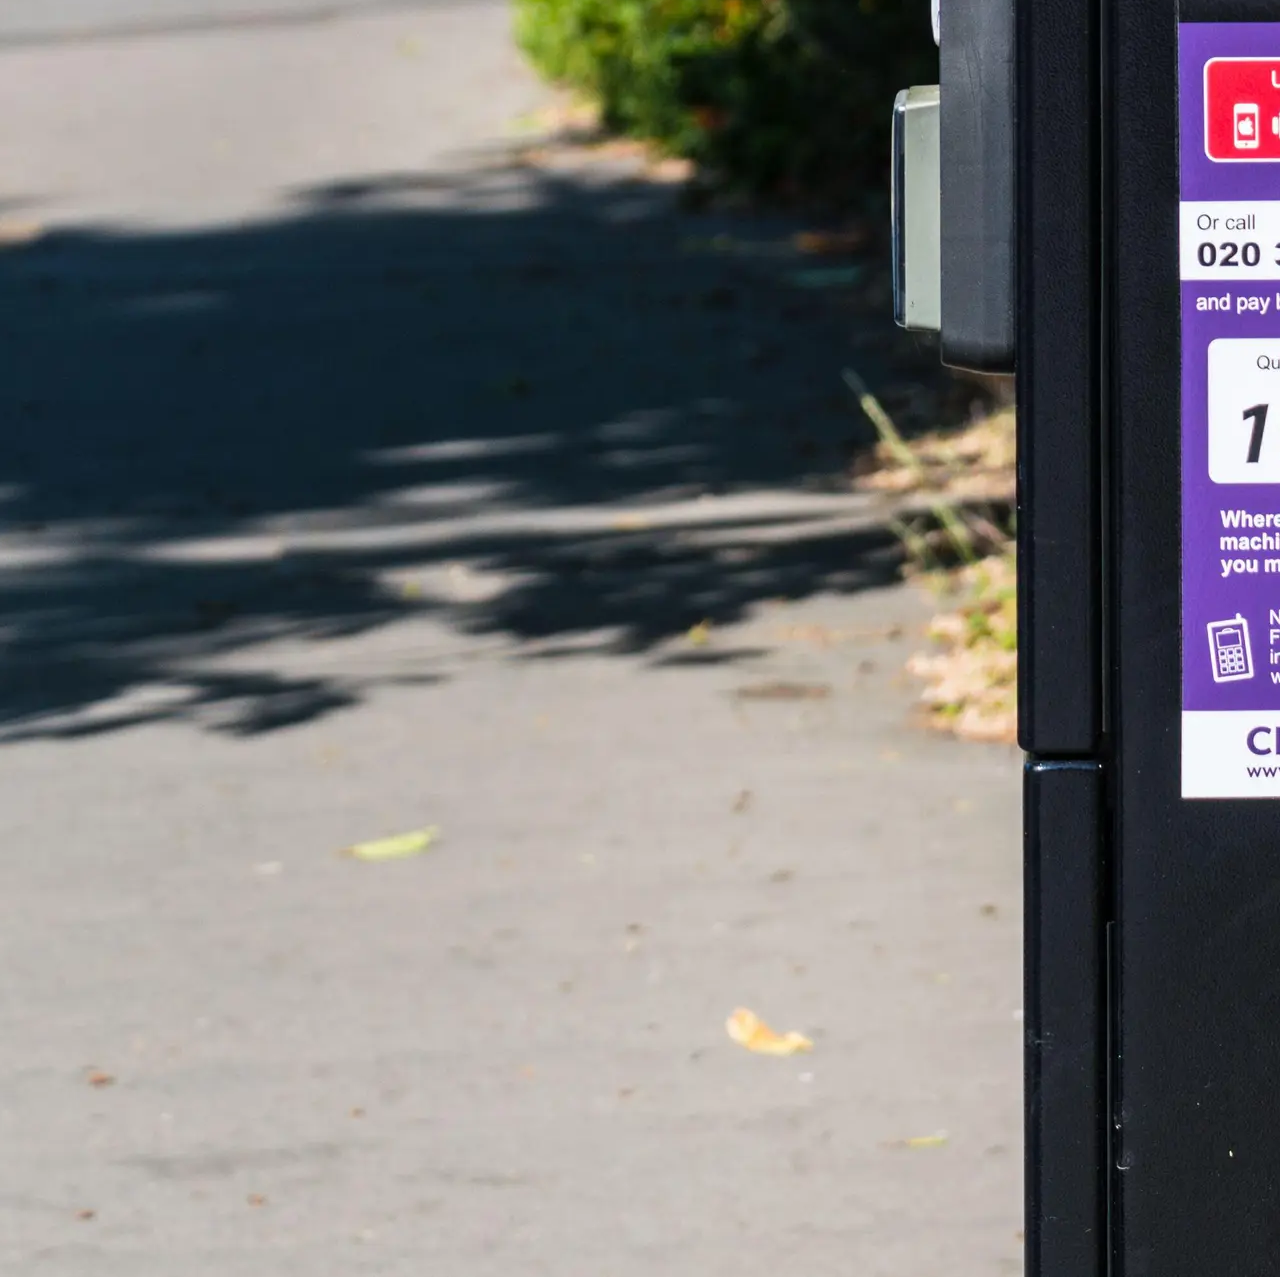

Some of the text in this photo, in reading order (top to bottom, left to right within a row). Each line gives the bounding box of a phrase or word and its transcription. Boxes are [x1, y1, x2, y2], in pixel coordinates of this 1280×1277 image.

[1196, 213, 1256, 231] Or call
[1197, 242, 1261, 267] 020
[1195, 292, 1231, 311] and
[1236, 296, 1271, 315] pay
[1220, 558, 1259, 577] you
